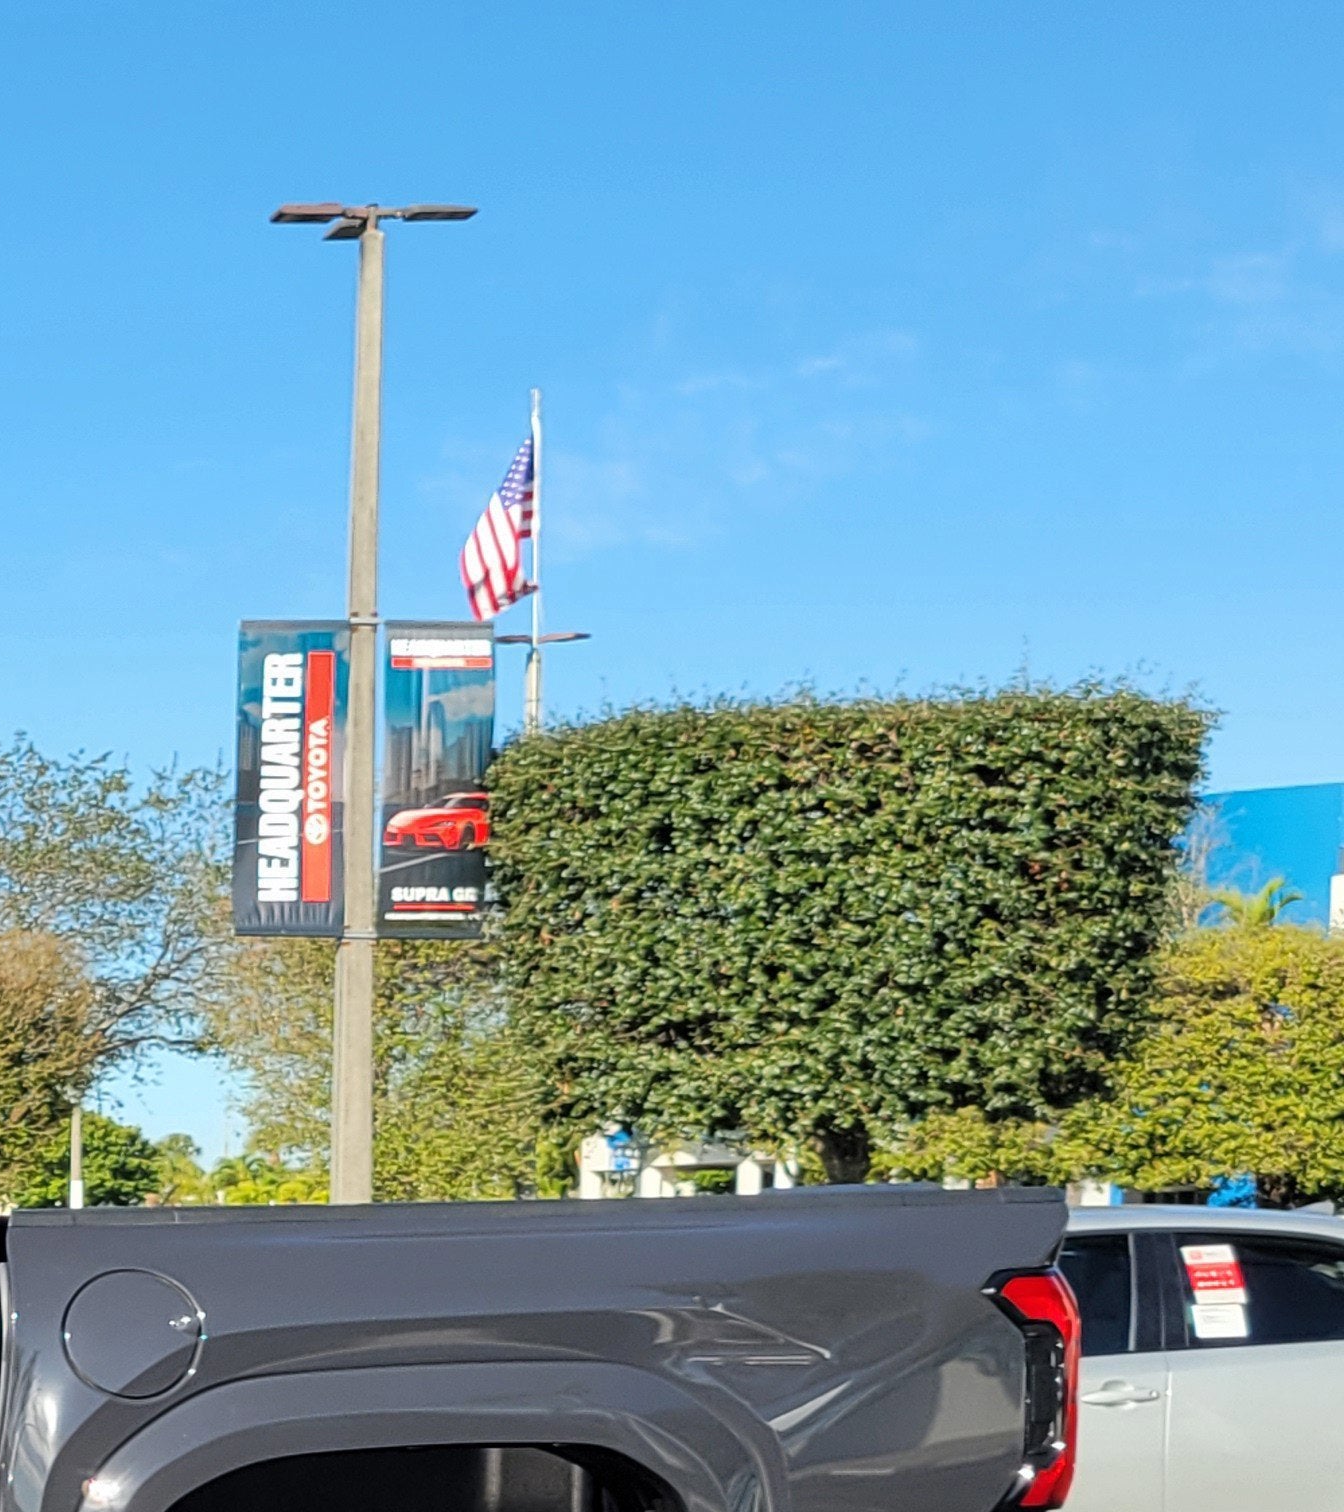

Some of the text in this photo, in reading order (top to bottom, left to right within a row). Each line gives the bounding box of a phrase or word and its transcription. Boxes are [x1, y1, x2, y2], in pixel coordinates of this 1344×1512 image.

[257, 652, 305, 903] HEADQUARTER
[307, 718, 330, 813] TOYOTA
[391, 887, 450, 901] SUPRA
